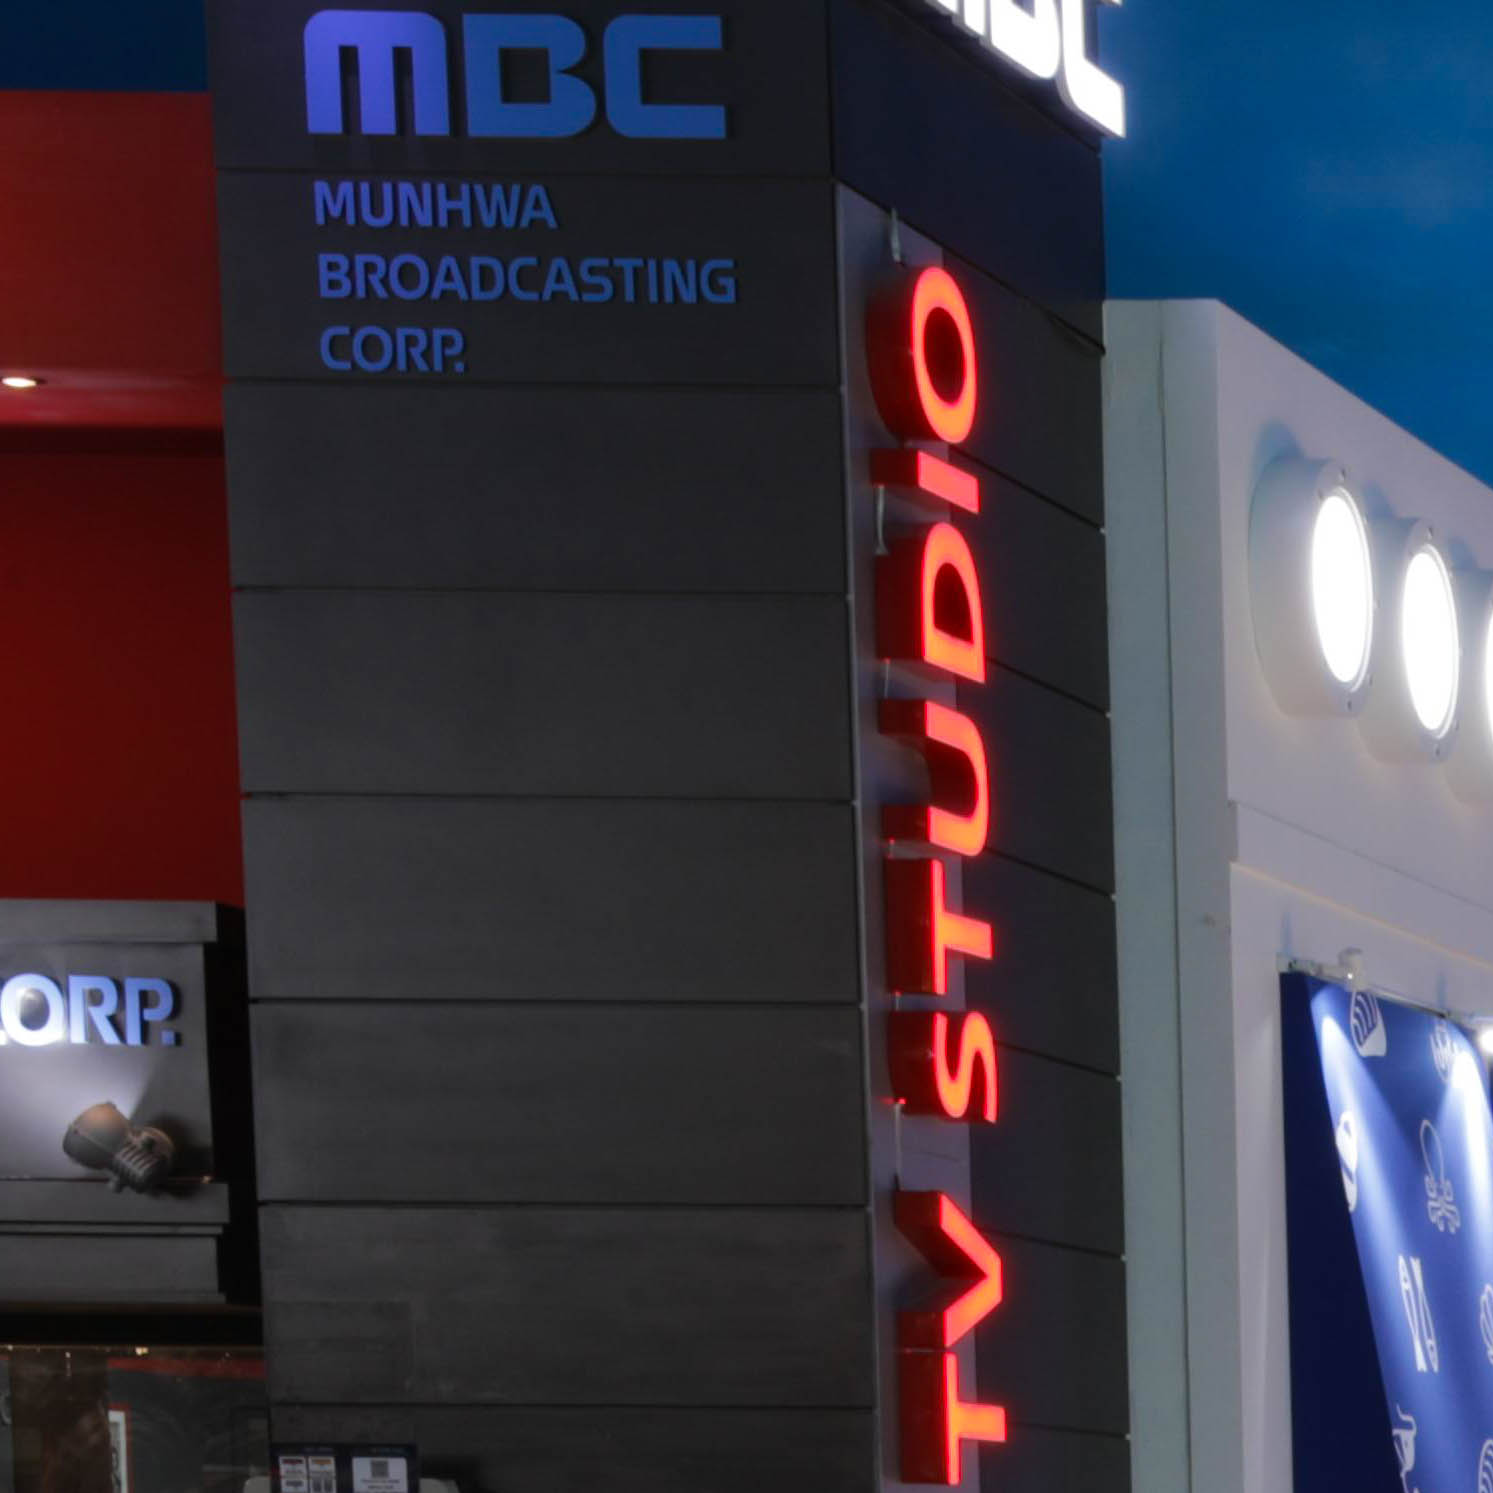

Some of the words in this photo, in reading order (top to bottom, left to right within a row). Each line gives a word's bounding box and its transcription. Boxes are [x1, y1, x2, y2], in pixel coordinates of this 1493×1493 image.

[303, 9, 727, 139] MBC
[935, 0, 1126, 138] BC
[313, 180, 558, 230] MUNHWA
[318, 252, 738, 304] BROADCASTING
[319, 325, 466, 373] CORP.
[911, 265, 998, 1124] STUDIO
[0, 974, 178, 1047] ORP.
[940, 1191, 1006, 1486] TV
